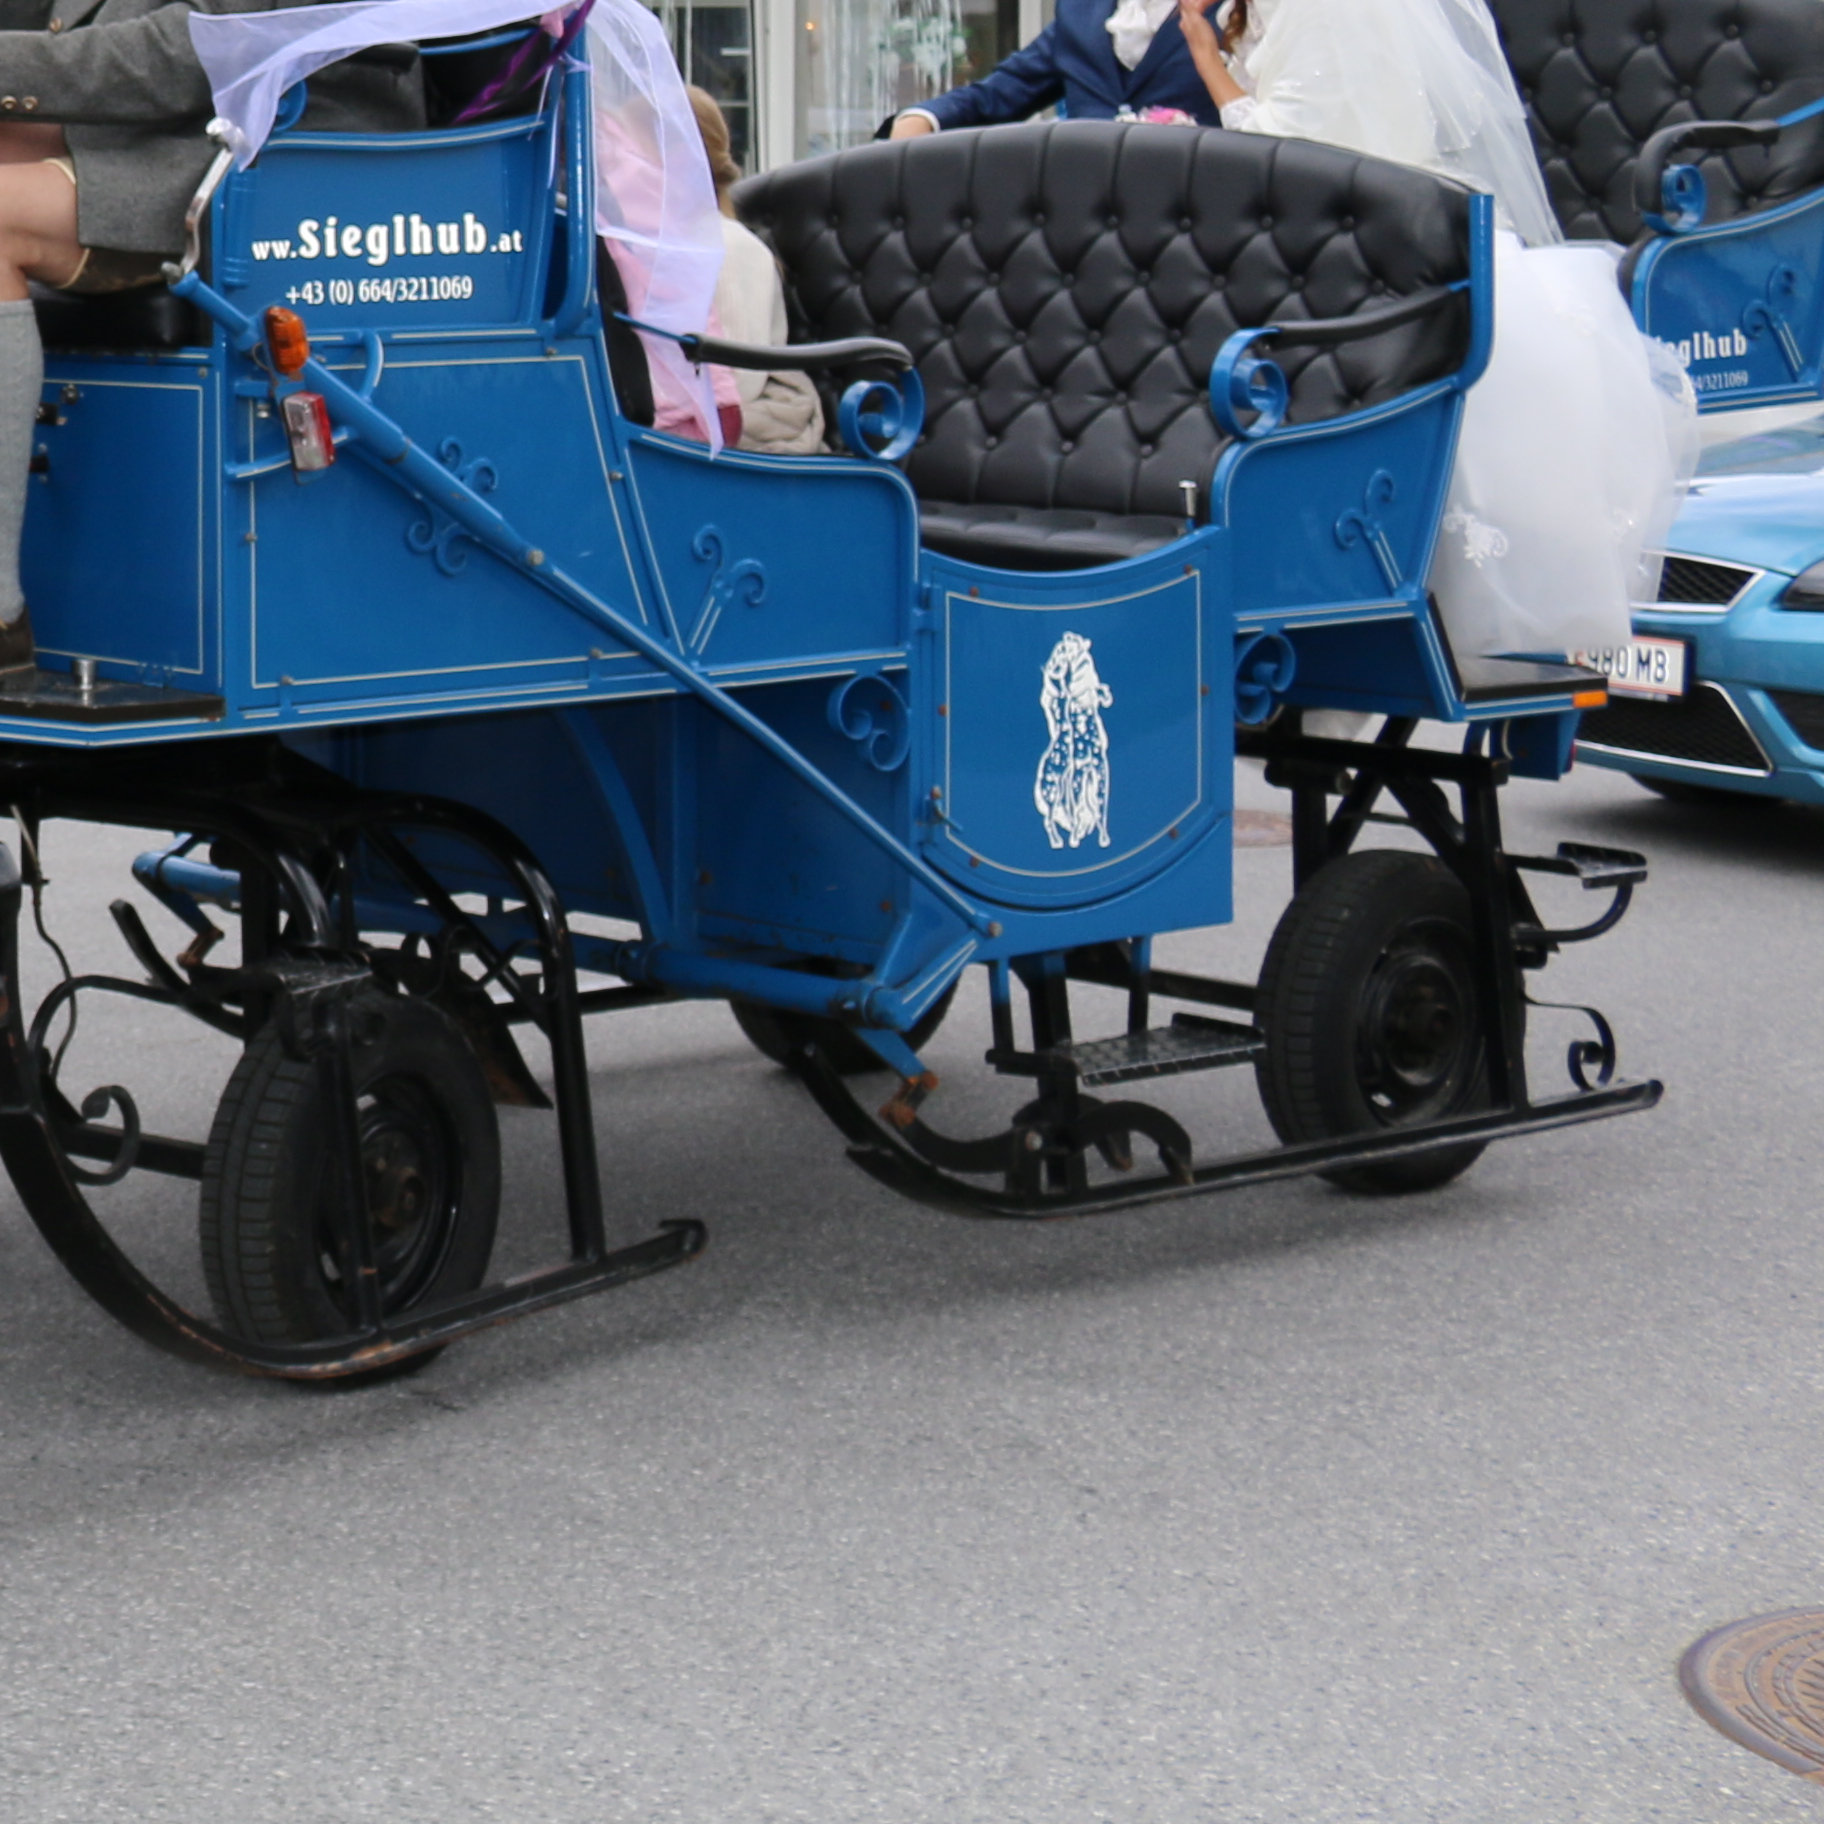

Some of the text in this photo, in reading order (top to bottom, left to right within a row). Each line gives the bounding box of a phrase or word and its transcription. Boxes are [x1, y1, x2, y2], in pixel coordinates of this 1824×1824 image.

[285, 275, 474, 306] +43 (0) 664/3211069
